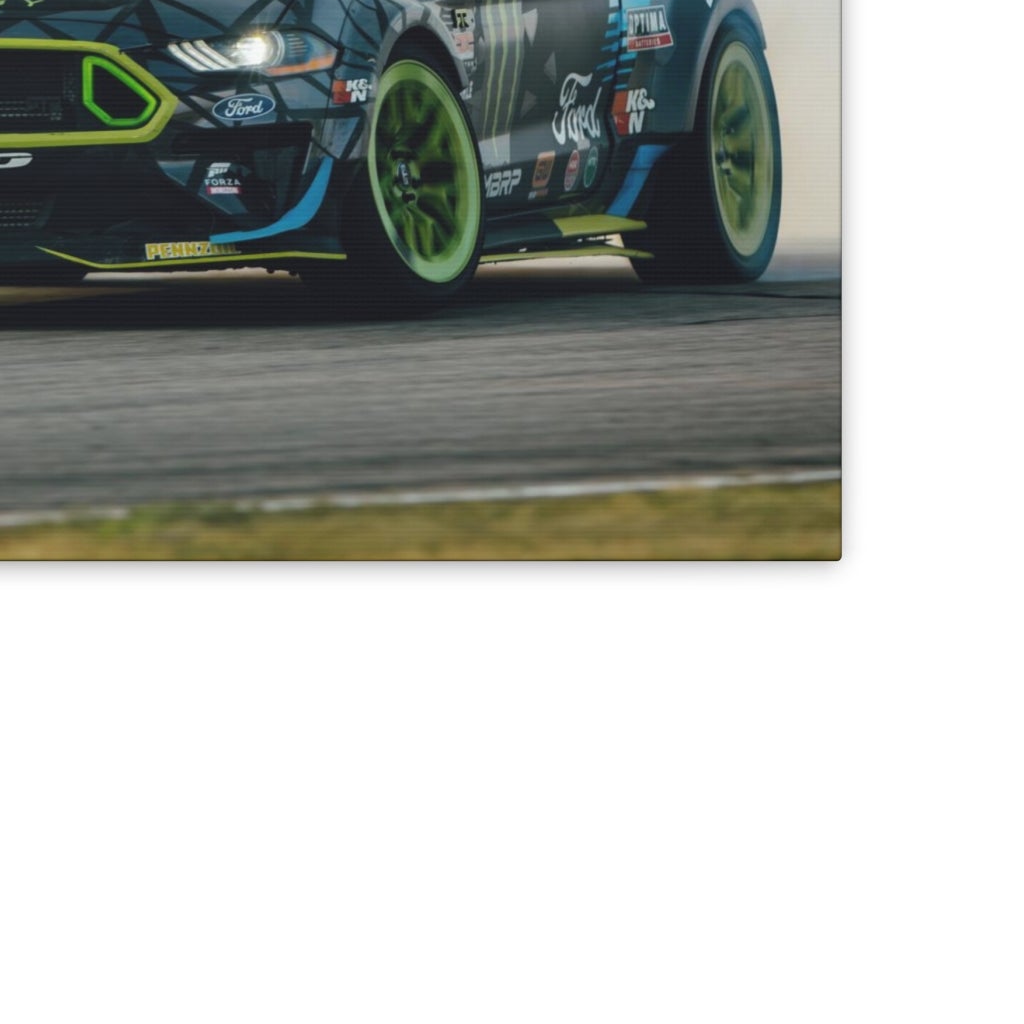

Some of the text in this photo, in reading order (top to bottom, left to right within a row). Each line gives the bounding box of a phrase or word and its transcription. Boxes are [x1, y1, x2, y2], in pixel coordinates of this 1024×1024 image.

[628, 9, 667, 36] OPTIMA
[224, 97, 265, 118] Ford
[552, 72, 603, 146] Ford
[204, 178, 242, 187] FORZA
